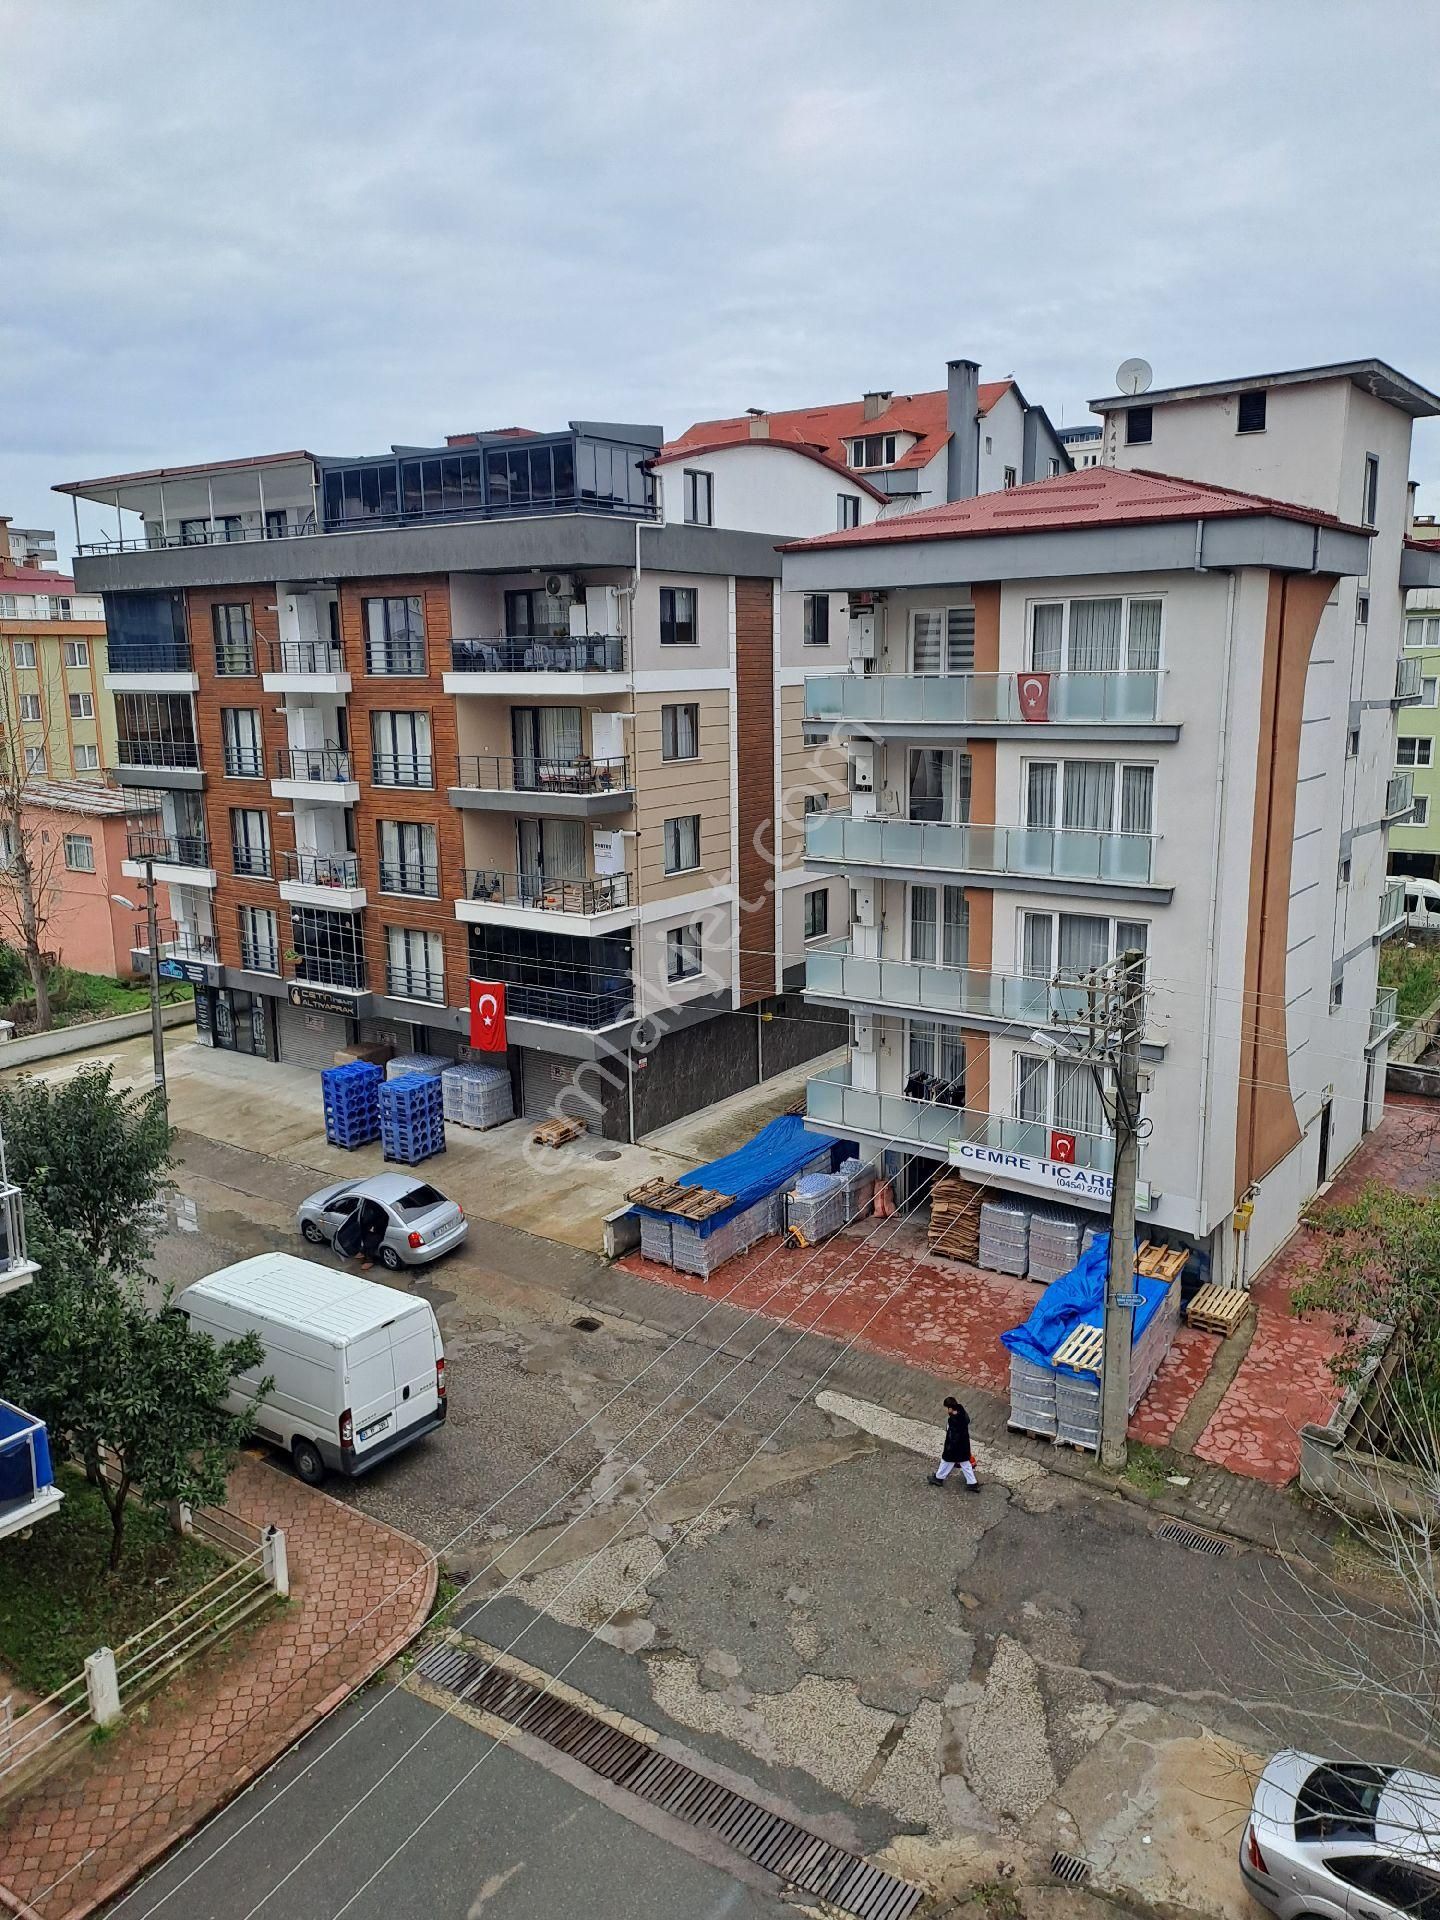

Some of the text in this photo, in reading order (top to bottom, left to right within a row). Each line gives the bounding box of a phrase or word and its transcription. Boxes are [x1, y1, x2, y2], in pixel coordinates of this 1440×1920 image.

[960, 1145, 1114, 1189] CEMRE TiCARE
[1056, 1177, 1085, 1191] (0454)
[1087, 1185, 1105, 1196] 270
